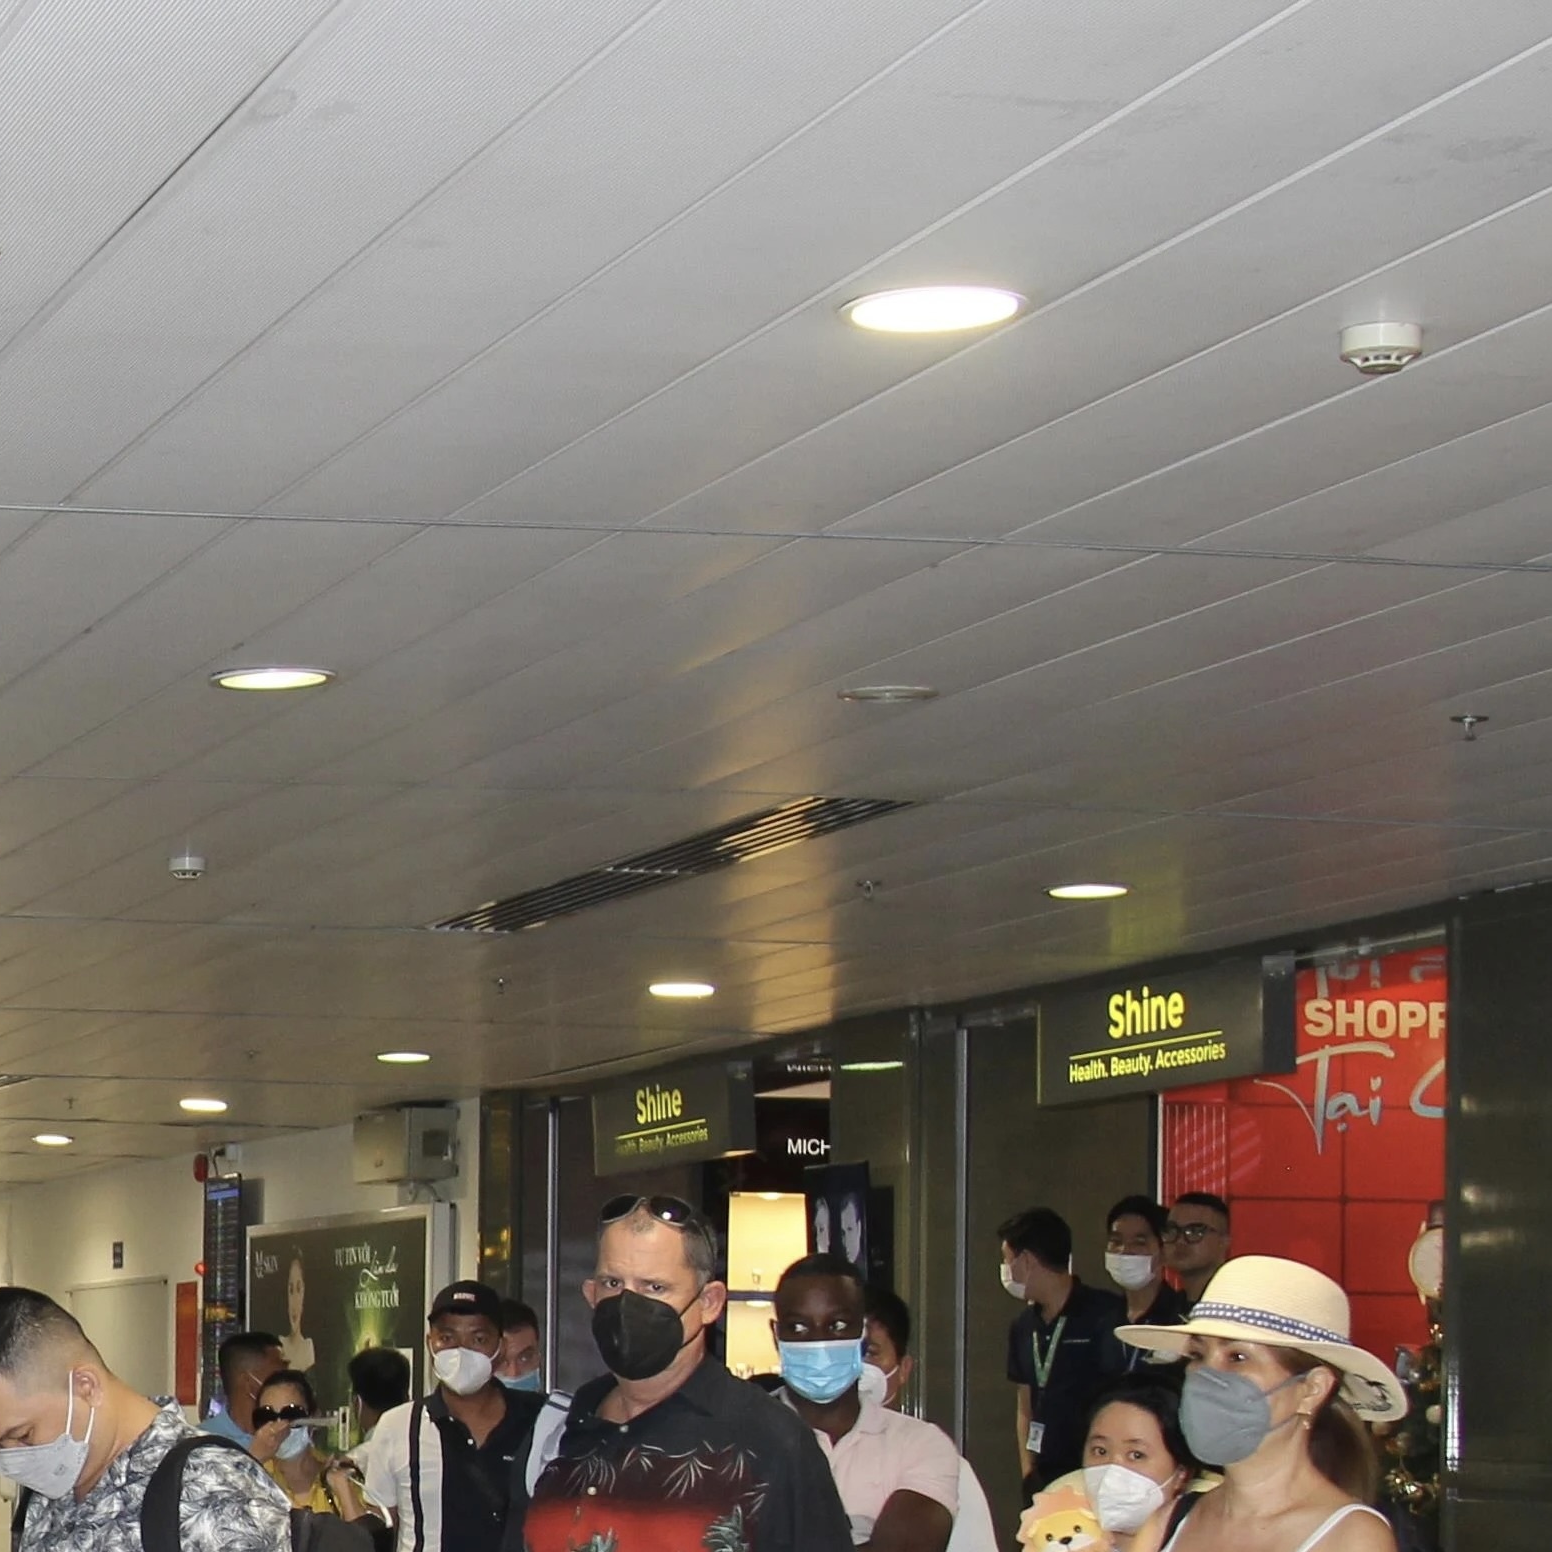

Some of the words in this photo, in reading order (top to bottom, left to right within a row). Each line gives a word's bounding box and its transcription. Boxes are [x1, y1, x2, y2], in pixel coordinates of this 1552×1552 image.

[1108, 986, 1185, 1039] Shine
[1069, 1061, 1108, 1084] Health.
[1110, 1053, 1153, 1077] Beauty.
[1155, 1039, 1226, 1070] Accessories
[635, 1083, 683, 1124] Shine
[666, 1126, 708, 1147] Accessories
